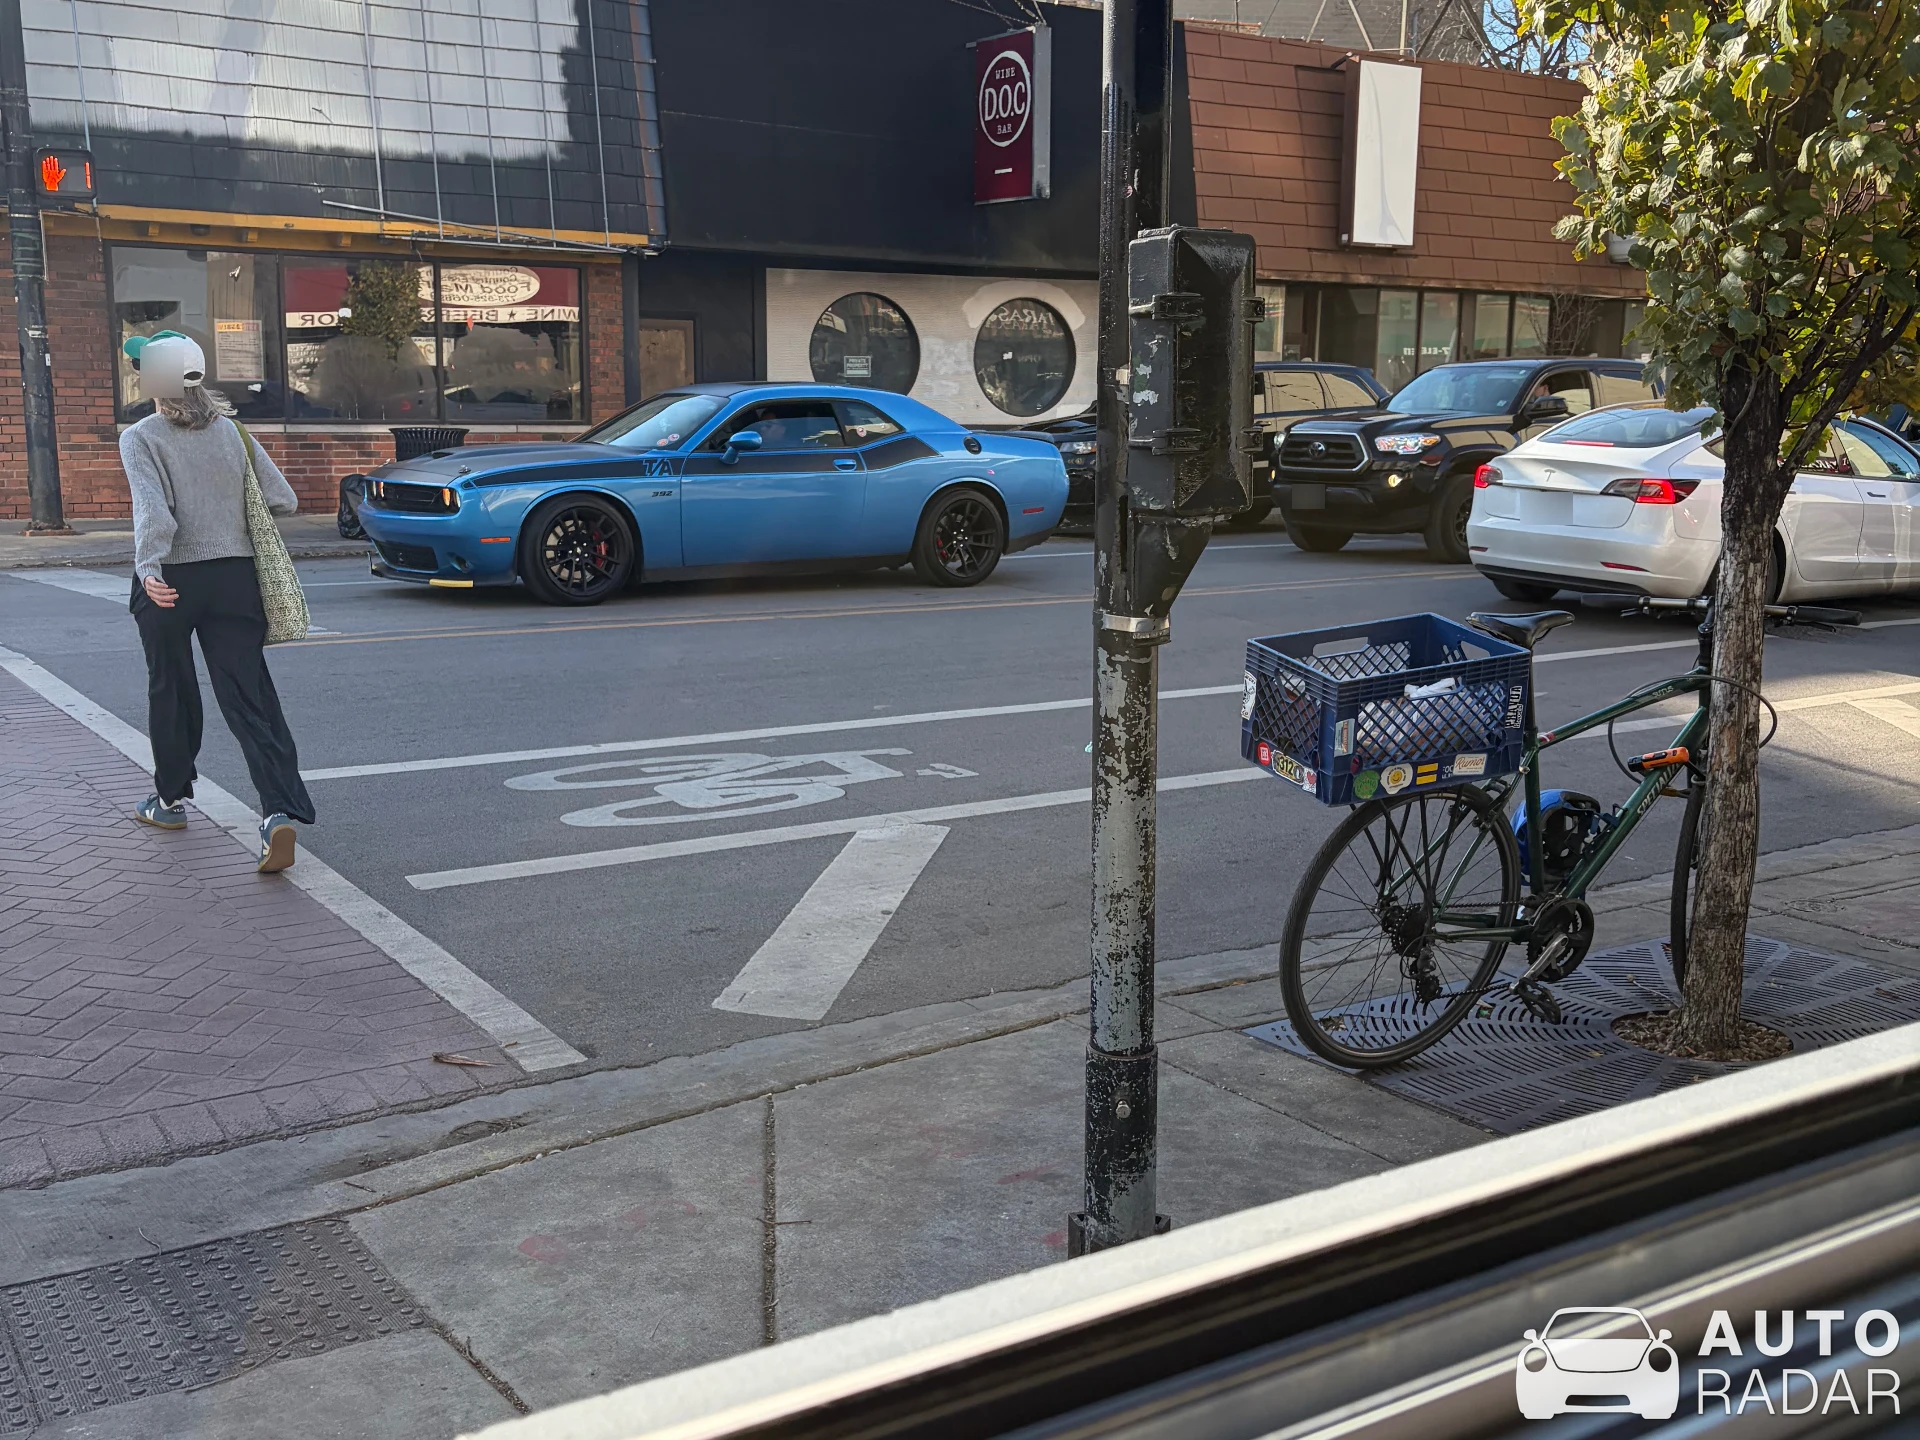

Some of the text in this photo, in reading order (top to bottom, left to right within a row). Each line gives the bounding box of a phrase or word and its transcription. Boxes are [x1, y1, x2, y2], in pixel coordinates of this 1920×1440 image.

[995, 67, 1016, 80] WINE
[997, 123, 1013, 135] BAR
[651, 490, 673, 498] 392
[1279, 756, 1294, 777] 312
[1637, 763, 1682, 816] SPECIALIZ
